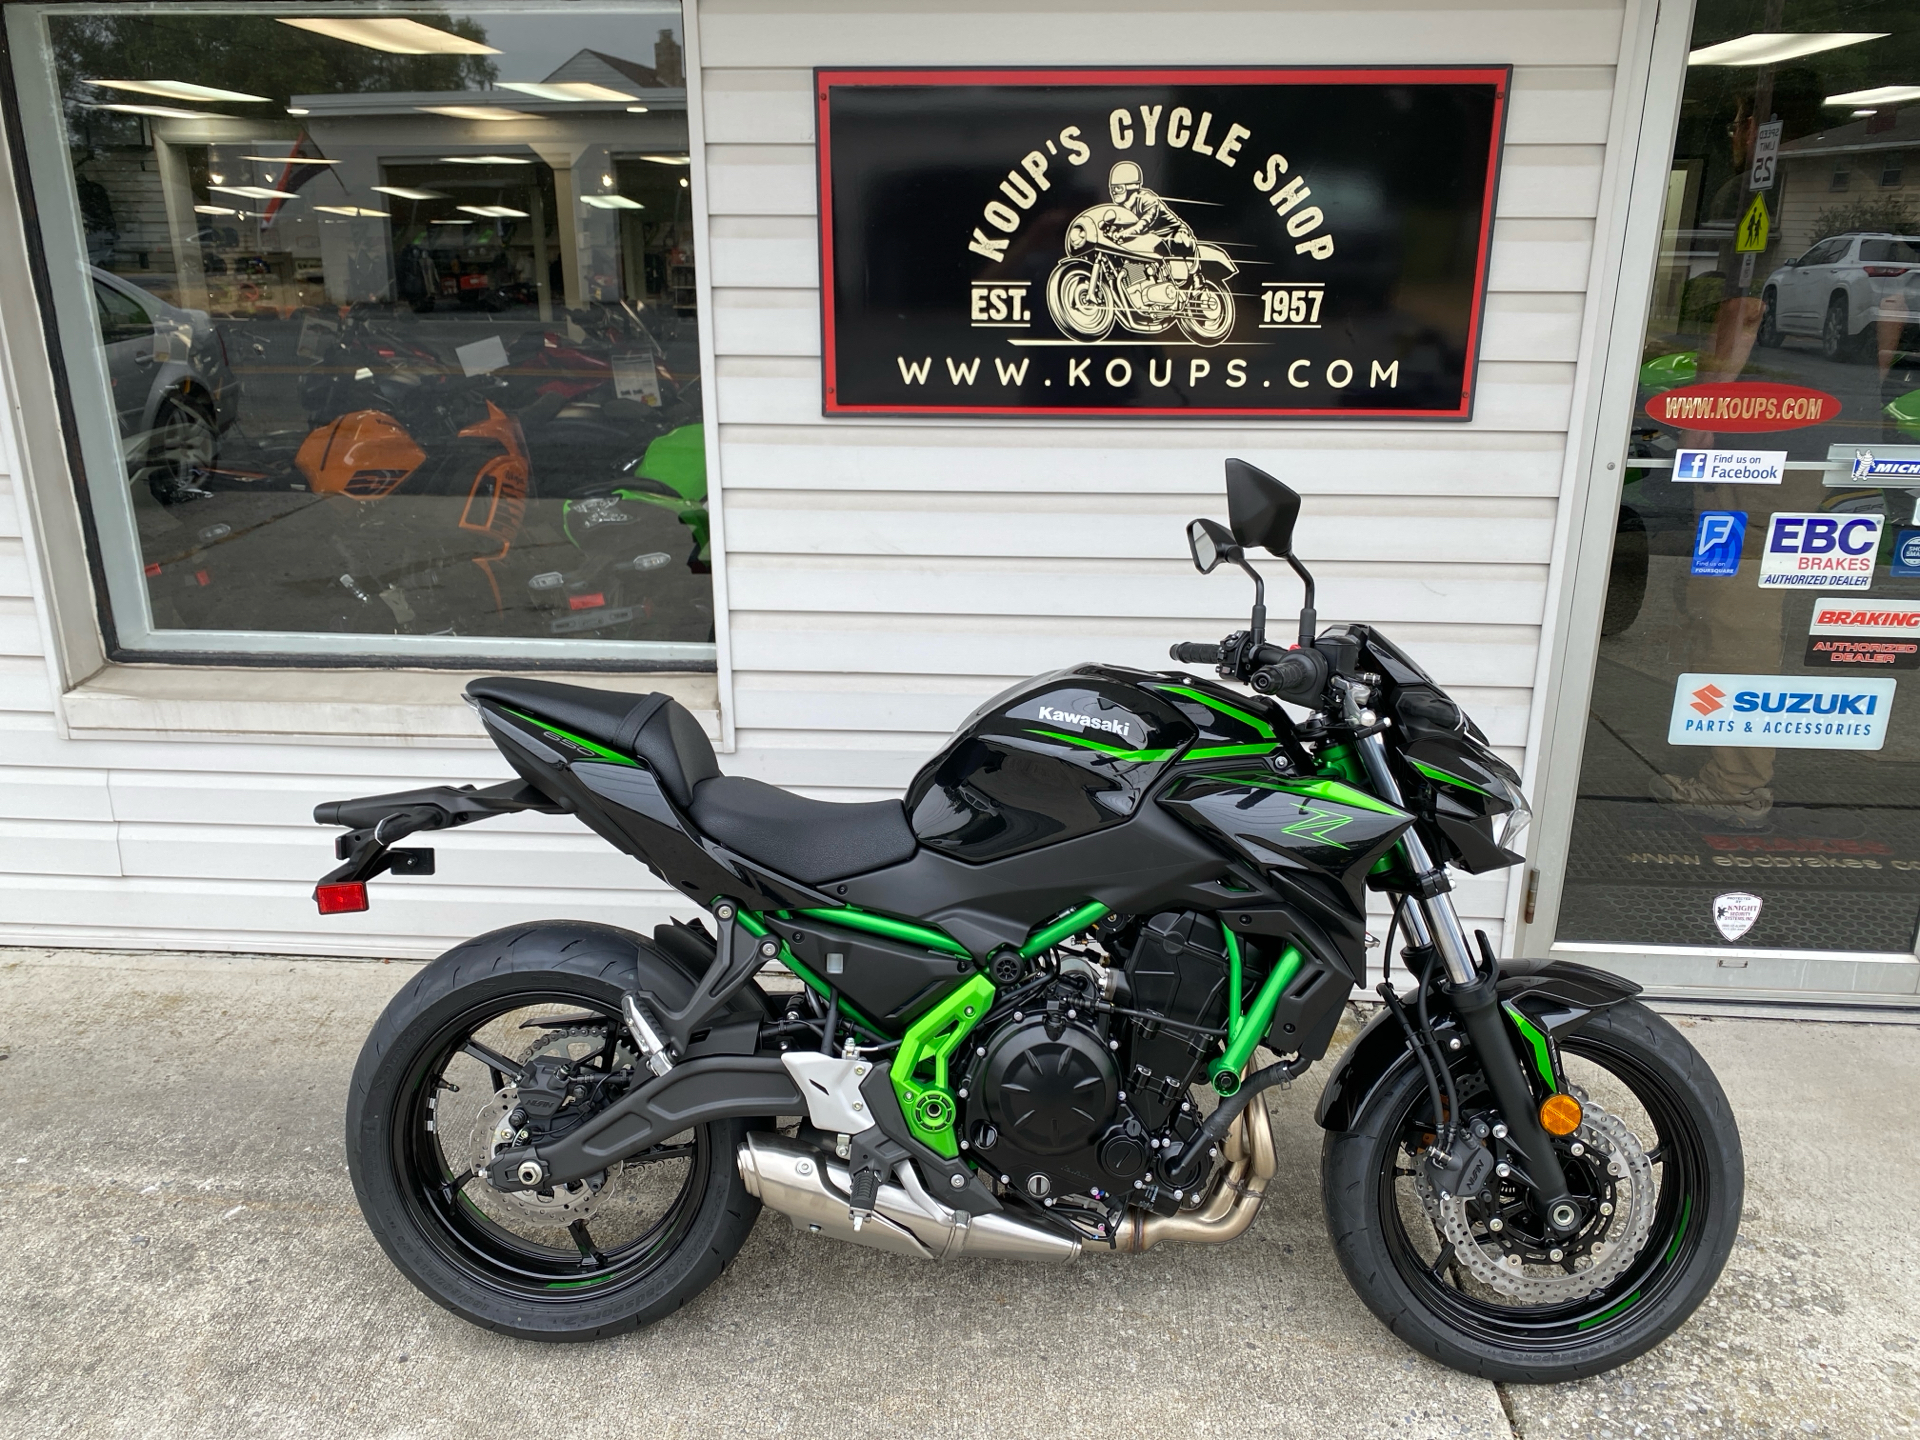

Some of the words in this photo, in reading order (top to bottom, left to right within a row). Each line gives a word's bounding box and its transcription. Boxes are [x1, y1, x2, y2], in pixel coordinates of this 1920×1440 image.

[968, 125, 1091, 263] KOUP'S
[1109, 105, 1251, 168] CYCLE
[1253, 153, 1335, 261] SHOP
[971, 288, 1031, 321] EST.
[1261, 290, 1324, 323] 1957
[897, 356, 1399, 390] WWW.KOUPS.COM
[1665, 397, 1823, 420] WWW.KOUPS.COM
[1713, 454, 1734, 464] Find
[1736, 456, 1747, 464] us
[1875, 463, 1920, 474] MICH
[1711, 465, 1778, 479] Facebook
[1770, 518, 1877, 555] EBC
[1797, 557, 1871, 571] BRAKES
[1764, 574, 1828, 585] AUTHORIZED
[1829, 576, 1869, 586] DEALER
[1816, 610, 1920, 628] BRAKING
[1813, 642, 1918, 653] AUTHORIZED
[1830, 652, 1896, 663] DEALER
[1733, 691, 1878, 715] SUZUKI
[1039, 706, 1130, 736] Kawasaki
[1685, 719, 1735, 732] PARTS
[1744, 721, 1753, 733] &
[1763, 721, 1872, 736] ACCESSORIES
[544, 731, 595, 756] 650
